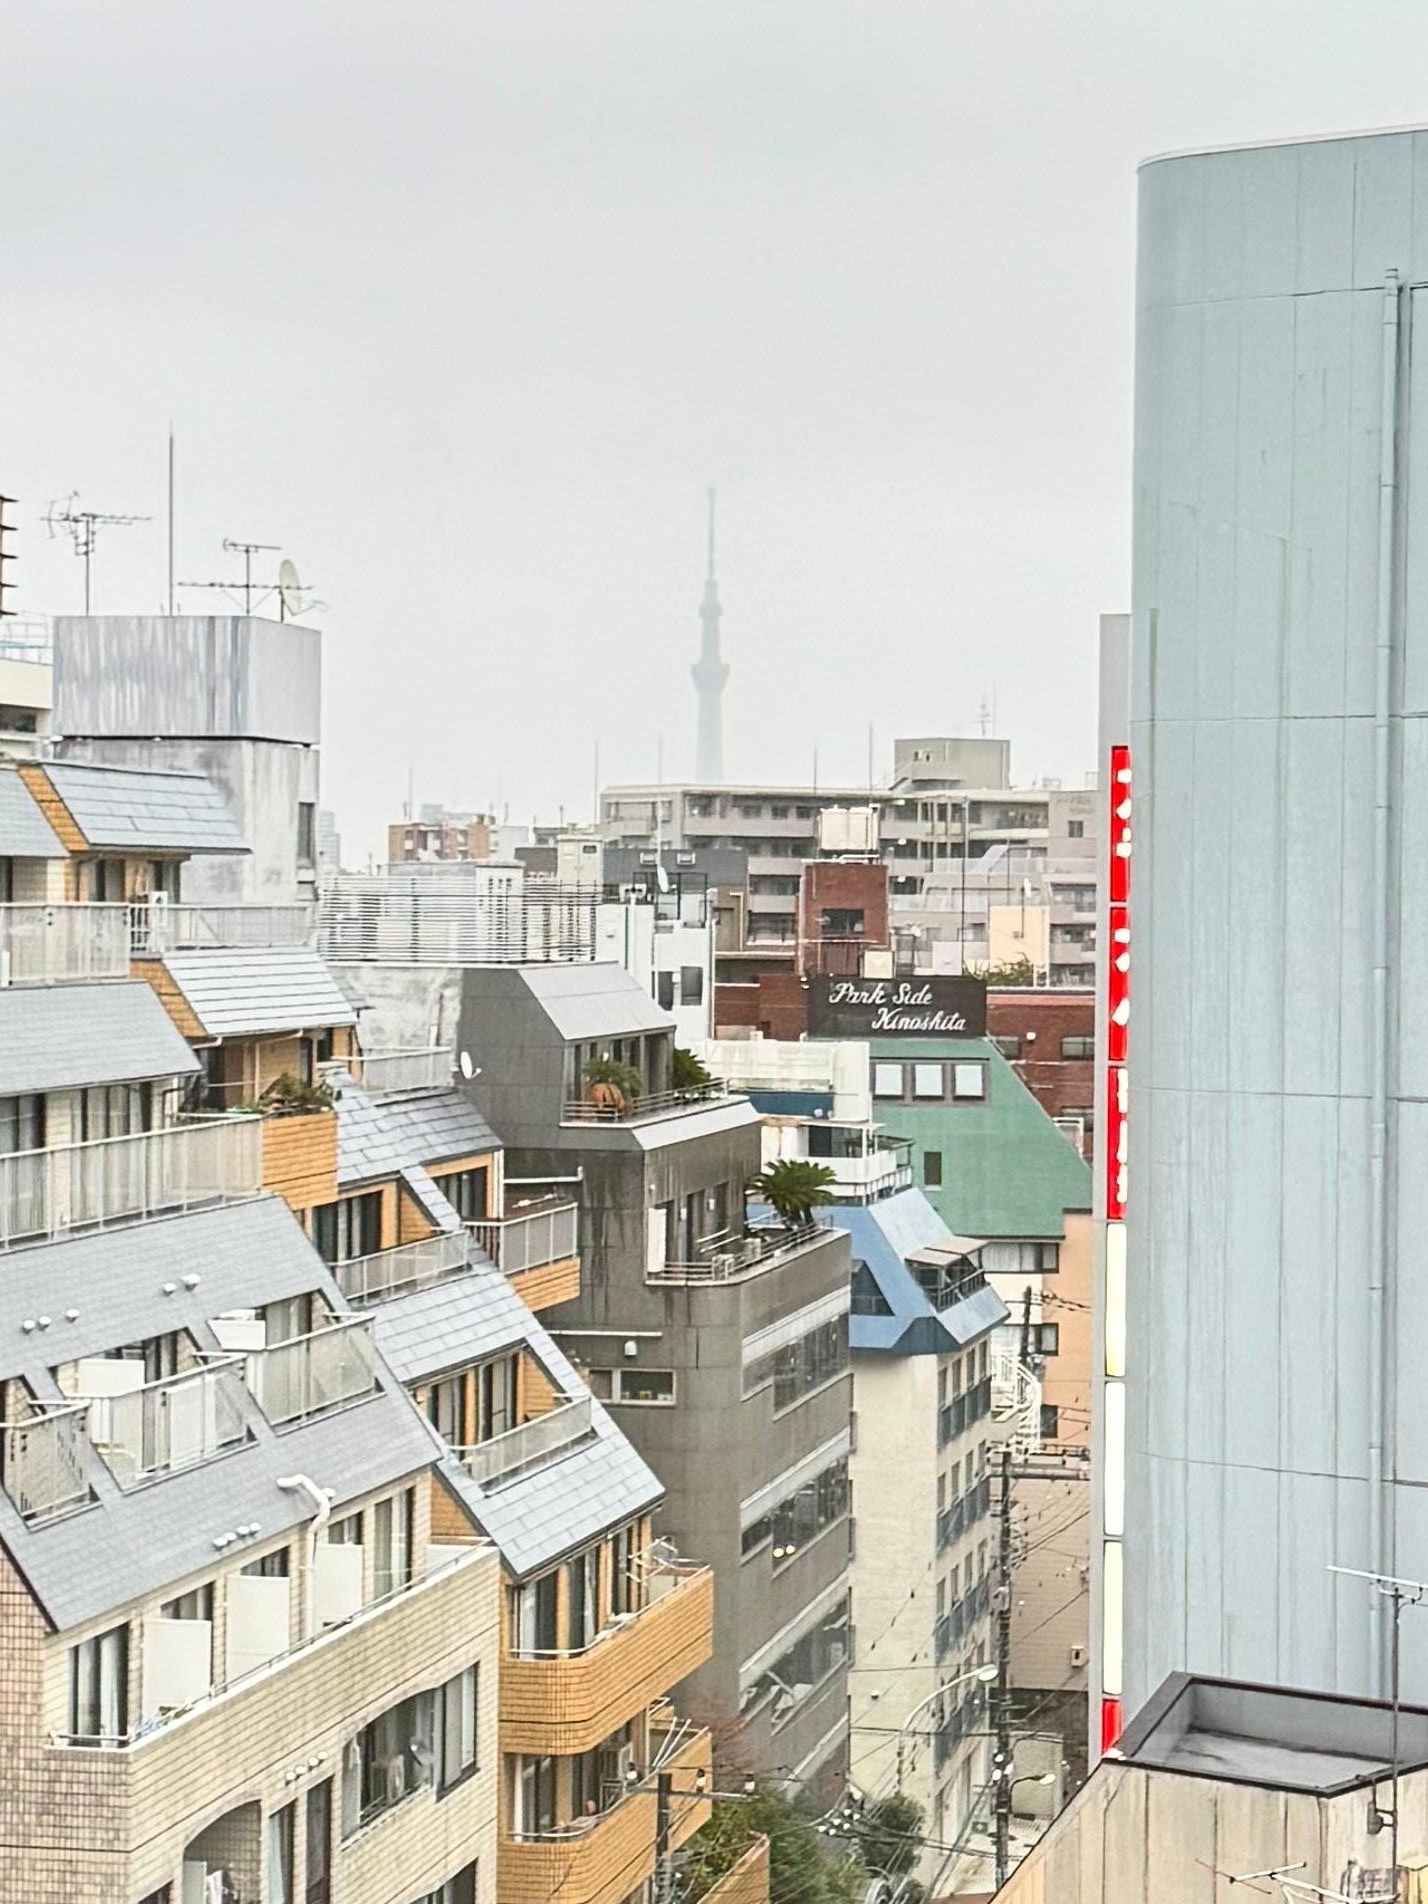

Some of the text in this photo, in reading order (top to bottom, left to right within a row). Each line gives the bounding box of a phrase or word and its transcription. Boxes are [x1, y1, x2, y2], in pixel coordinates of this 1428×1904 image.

[829, 982, 933, 1005] Park Side
[872, 1008, 967, 1031] Kinoshita
